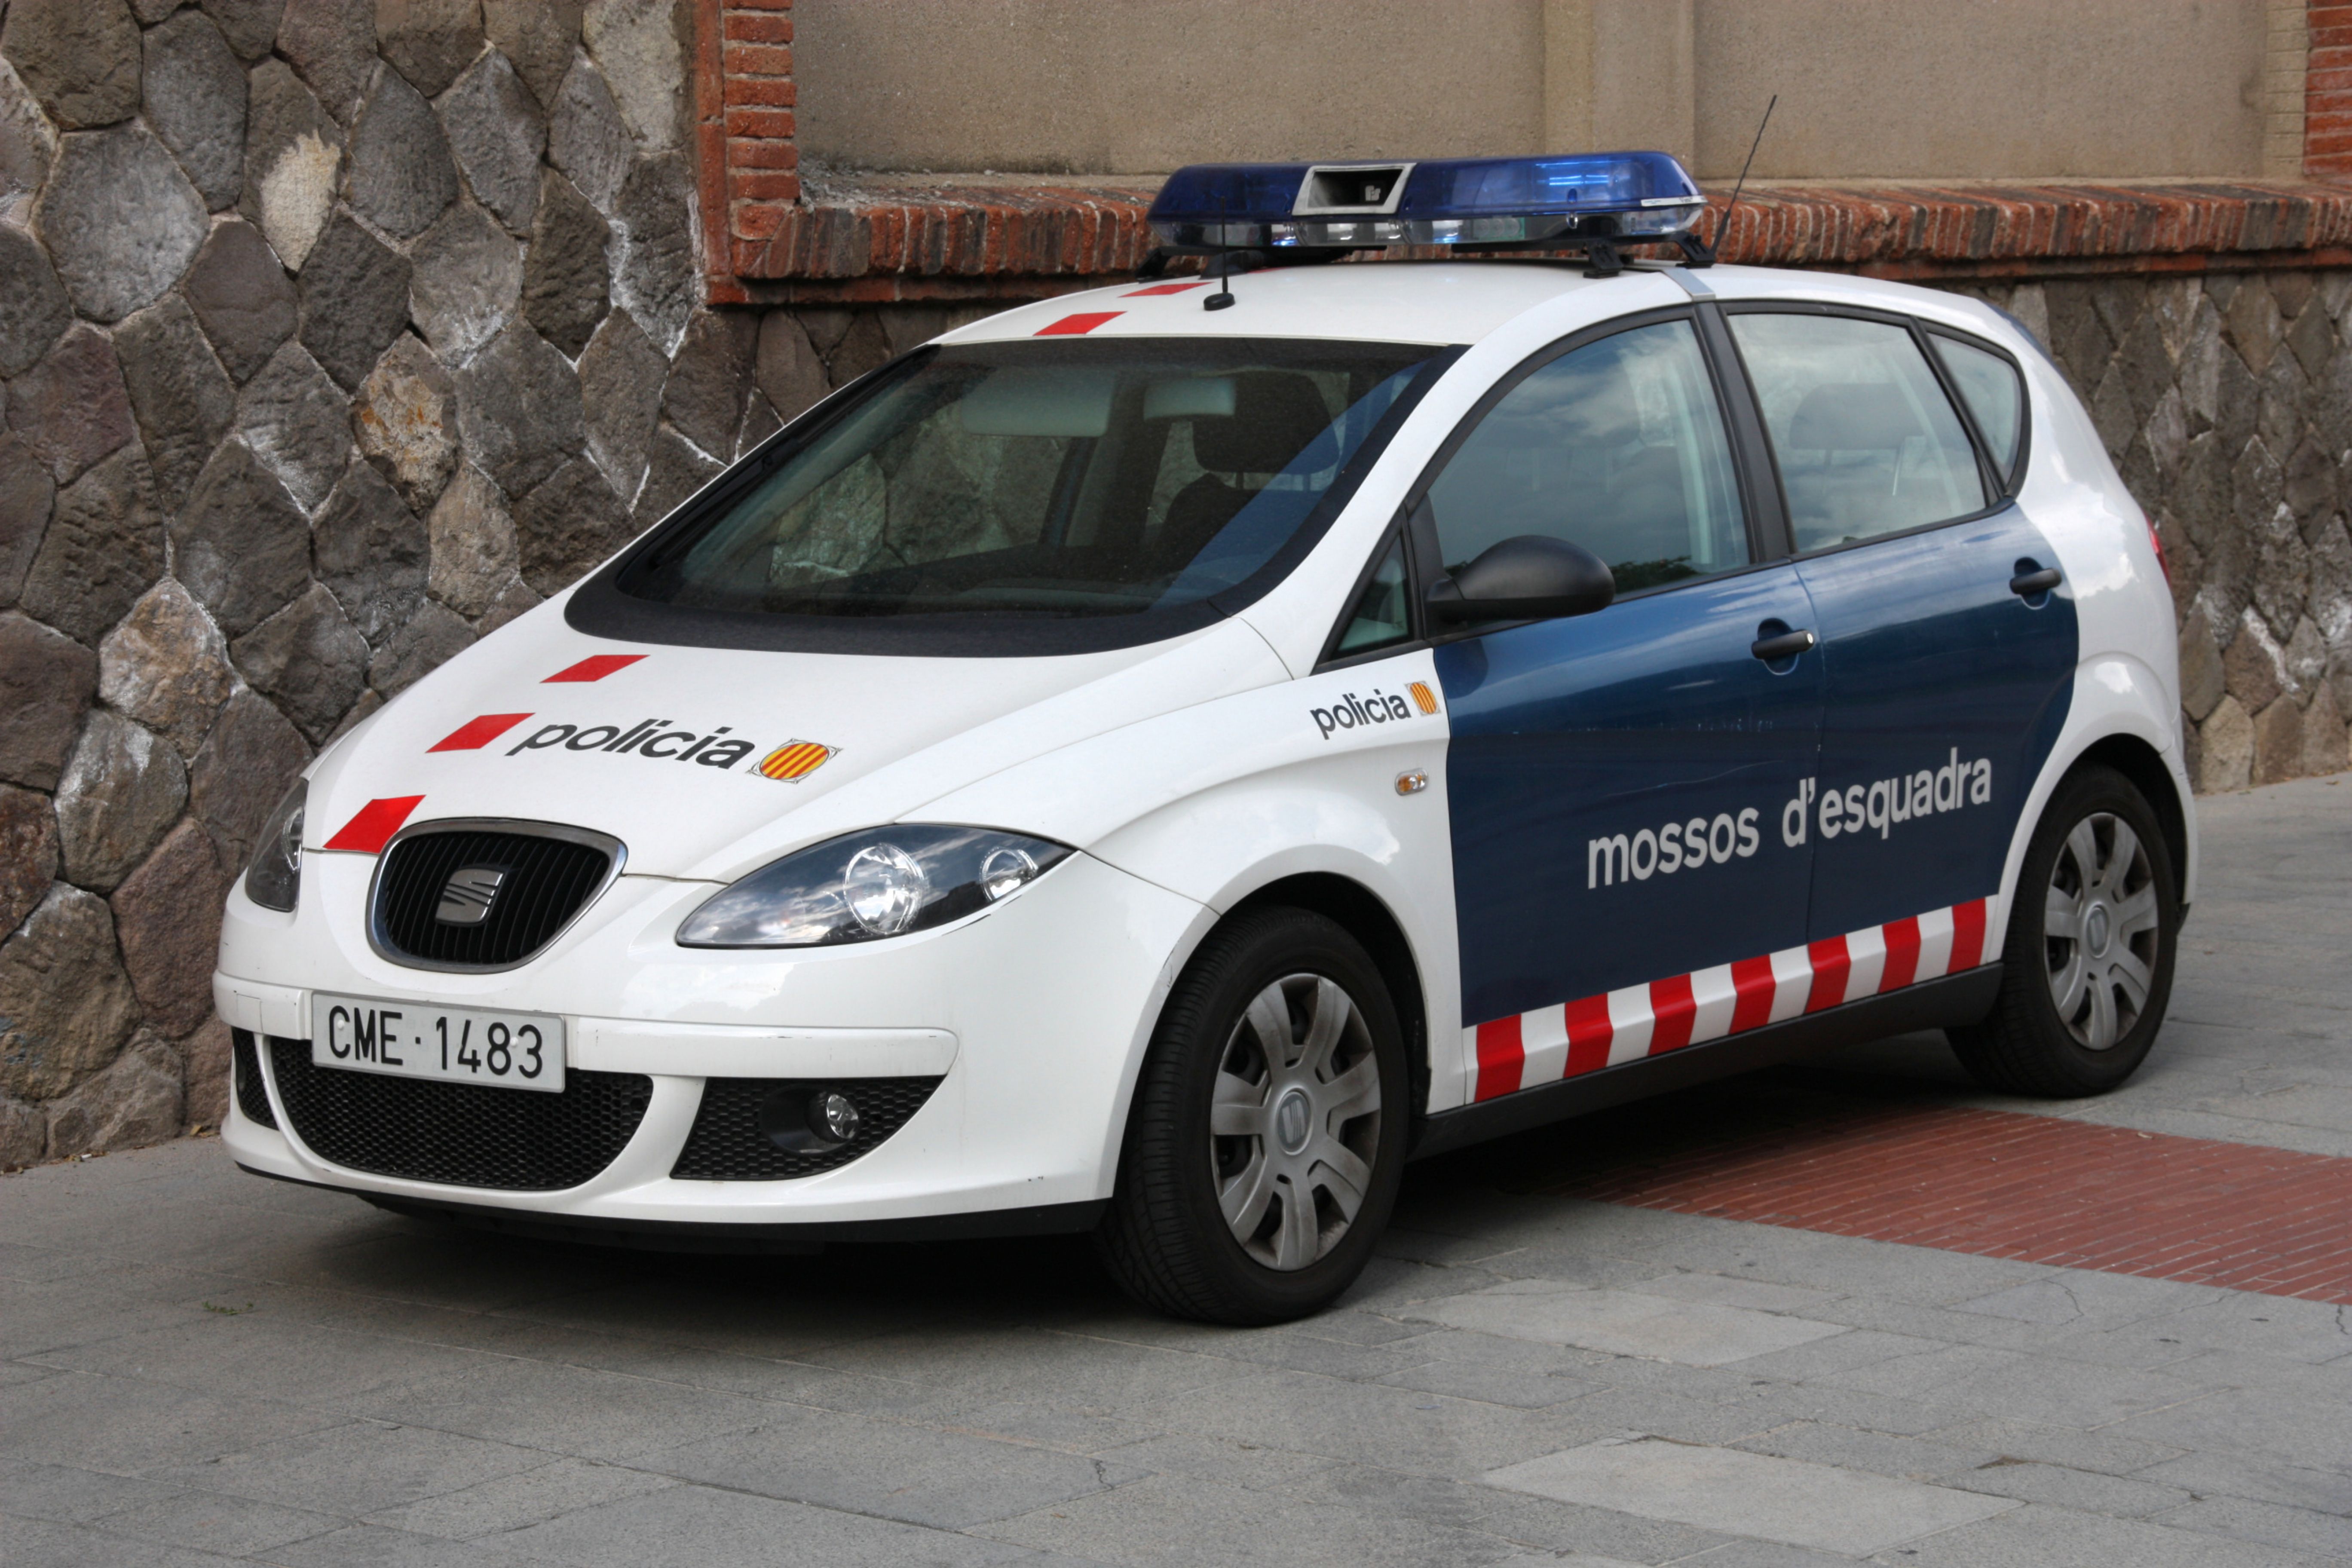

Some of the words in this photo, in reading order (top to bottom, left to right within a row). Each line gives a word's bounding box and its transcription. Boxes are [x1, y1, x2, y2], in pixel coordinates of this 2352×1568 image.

[1310, 689, 1412, 740] policia
[505, 719, 755, 769] policia
[1589, 808, 1759, 889] mossos
[1782, 747, 1991, 847] d'esquadra
